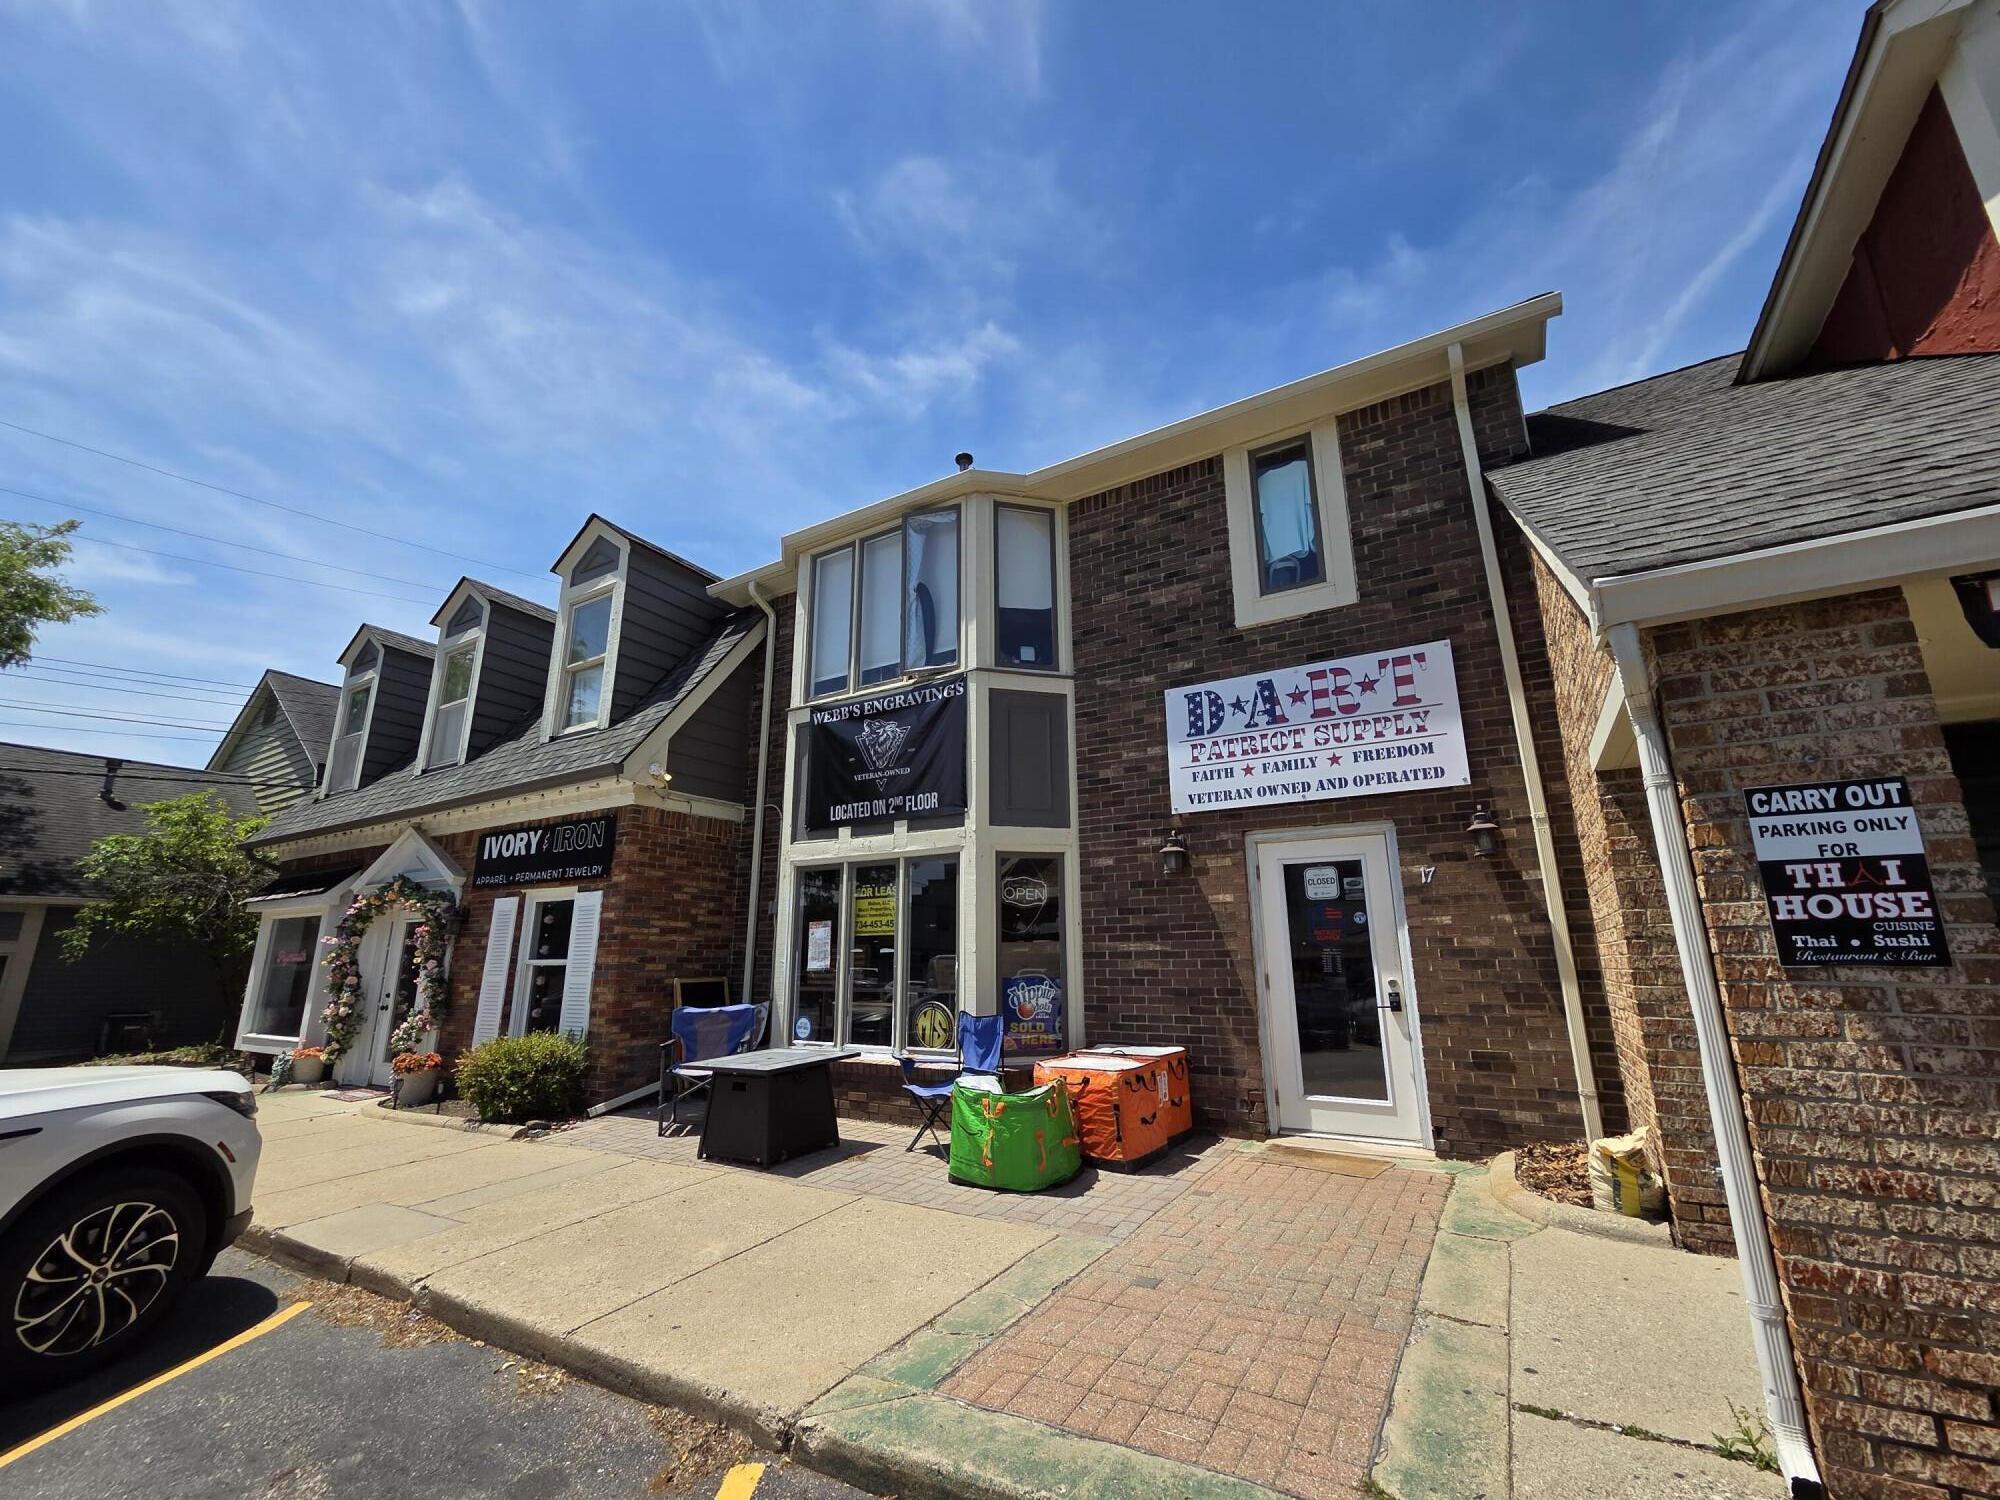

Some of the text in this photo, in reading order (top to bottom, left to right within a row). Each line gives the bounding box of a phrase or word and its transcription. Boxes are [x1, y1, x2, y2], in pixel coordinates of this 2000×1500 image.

[812, 682, 965, 725] WEBB'S ENGRAVINGS
[1190, 710, 1430, 763] PATRIOT SUPPLY
[1192, 742, 1435, 782] FAITH FAMILY FREEDOM
[854, 767, 911, 781] VETERAN-OWNED
[1188, 766, 1446, 804] VETERAN OWNED AND OPERATED
[1751, 782, 1902, 814] CARRY OUT
[830, 801, 871, 821] LOCATED
[873, 799, 886, 816] ON
[905, 792, 939, 812] FLOOR
[1758, 816, 1908, 838] PARKING ONLY
[483, 829, 542, 860] IVORY
[552, 821, 605, 853] IRON
[1817, 842, 1861, 857] FOR
[475, 865, 603, 885] APPAREL PERMANENT JEWELRY
[1307, 877, 1336, 886] CLOSED
[1420, 866, 1435, 884] 17
[874, 886, 896, 897] LEAS
[1004, 886, 1045, 900] OPEN
[1772, 891, 1933, 920] HOUSE
[856, 919, 895, 930] 734-453-45
[1873, 921, 1936, 931] CUISINE
[1792, 934, 1931, 947] Thai Sushi
[1796, 949, 1937, 961] Restaurant & Bar
[1010, 1023, 1045, 1033] SOLD
[1022, 1034, 1057, 1045] HERE
